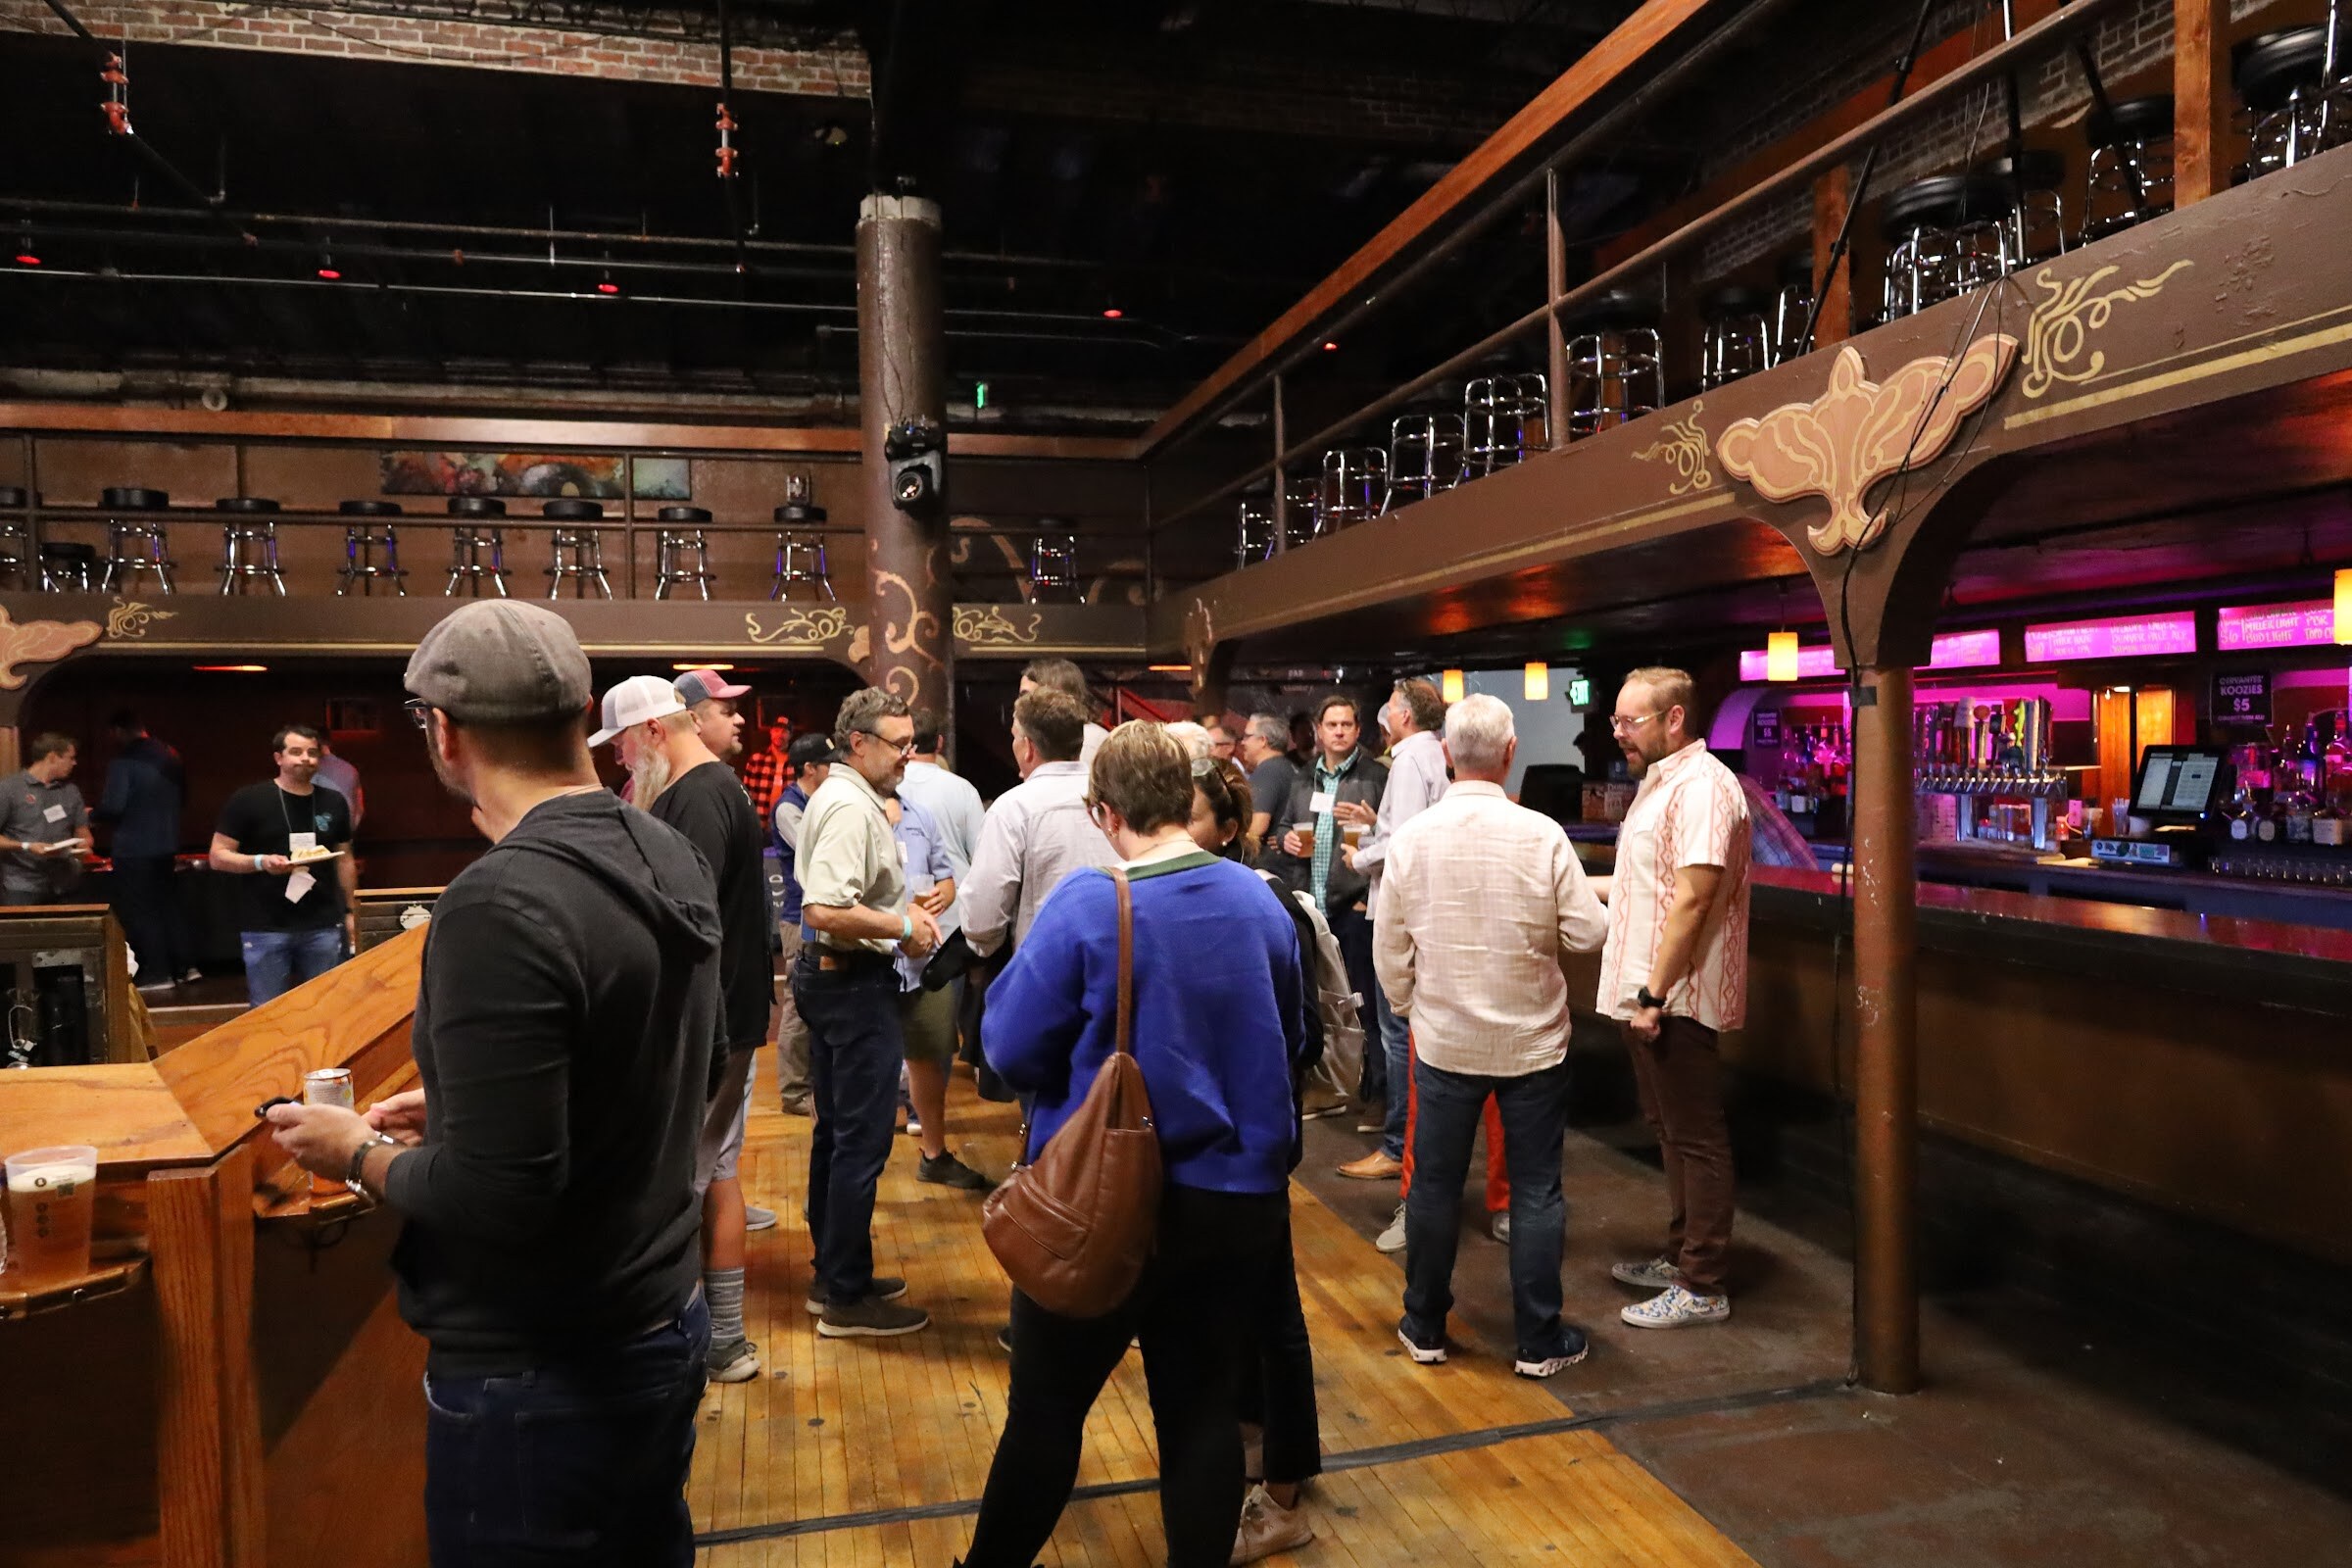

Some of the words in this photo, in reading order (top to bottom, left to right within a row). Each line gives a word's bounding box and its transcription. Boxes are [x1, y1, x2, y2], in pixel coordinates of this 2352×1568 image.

[2244, 618, 2275, 632] MILLER
[2275, 616, 2300, 628] LIGHT
[2245, 631, 2266, 644] BUD
[2266, 629, 2295, 643] LIGHT
[2220, 684, 2263, 696] KOOZIES
[2233, 697, 2250, 712] $5
